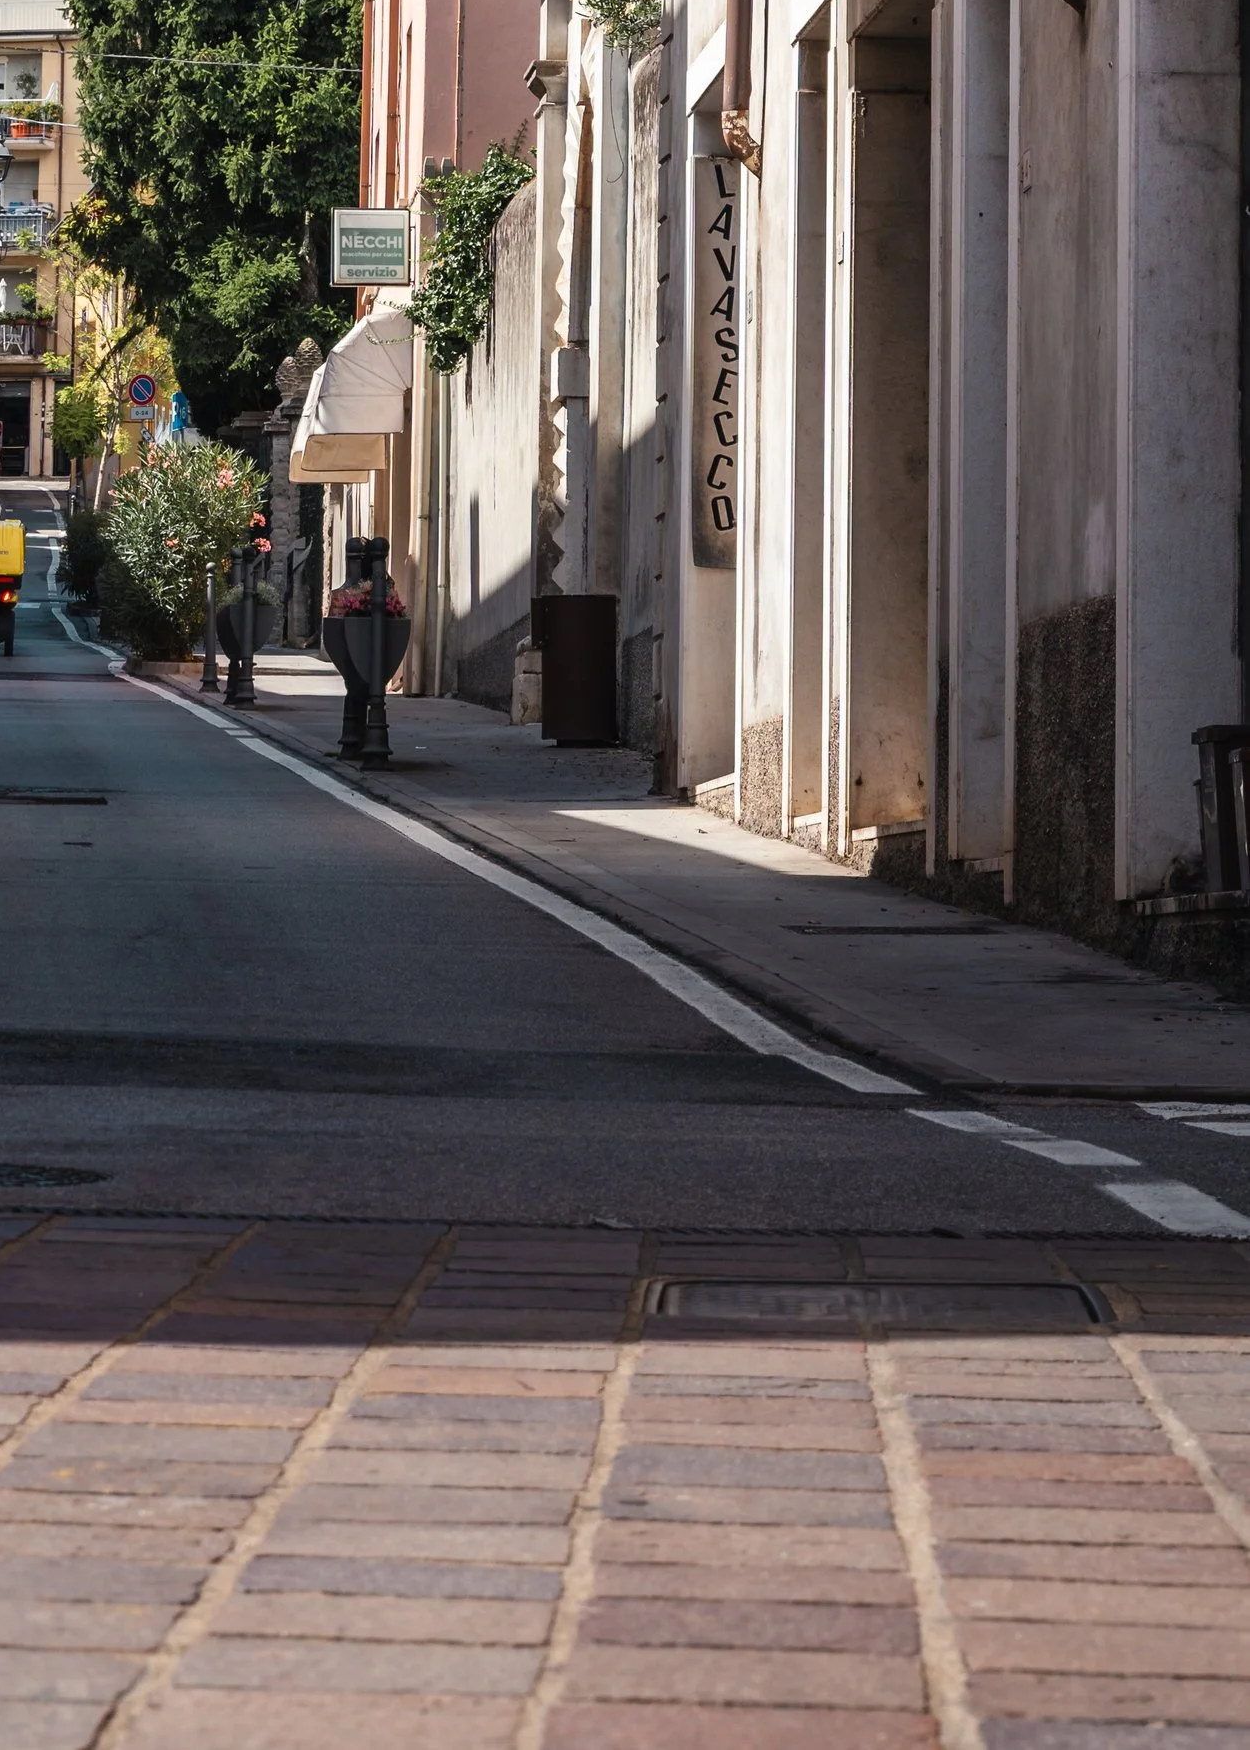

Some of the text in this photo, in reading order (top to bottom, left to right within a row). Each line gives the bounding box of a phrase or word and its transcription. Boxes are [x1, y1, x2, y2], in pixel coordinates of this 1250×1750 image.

[341, 235, 403, 248] NECCHI
[347, 266, 398, 277] servizio
[707, 164, 739, 531] LAVASECCO
